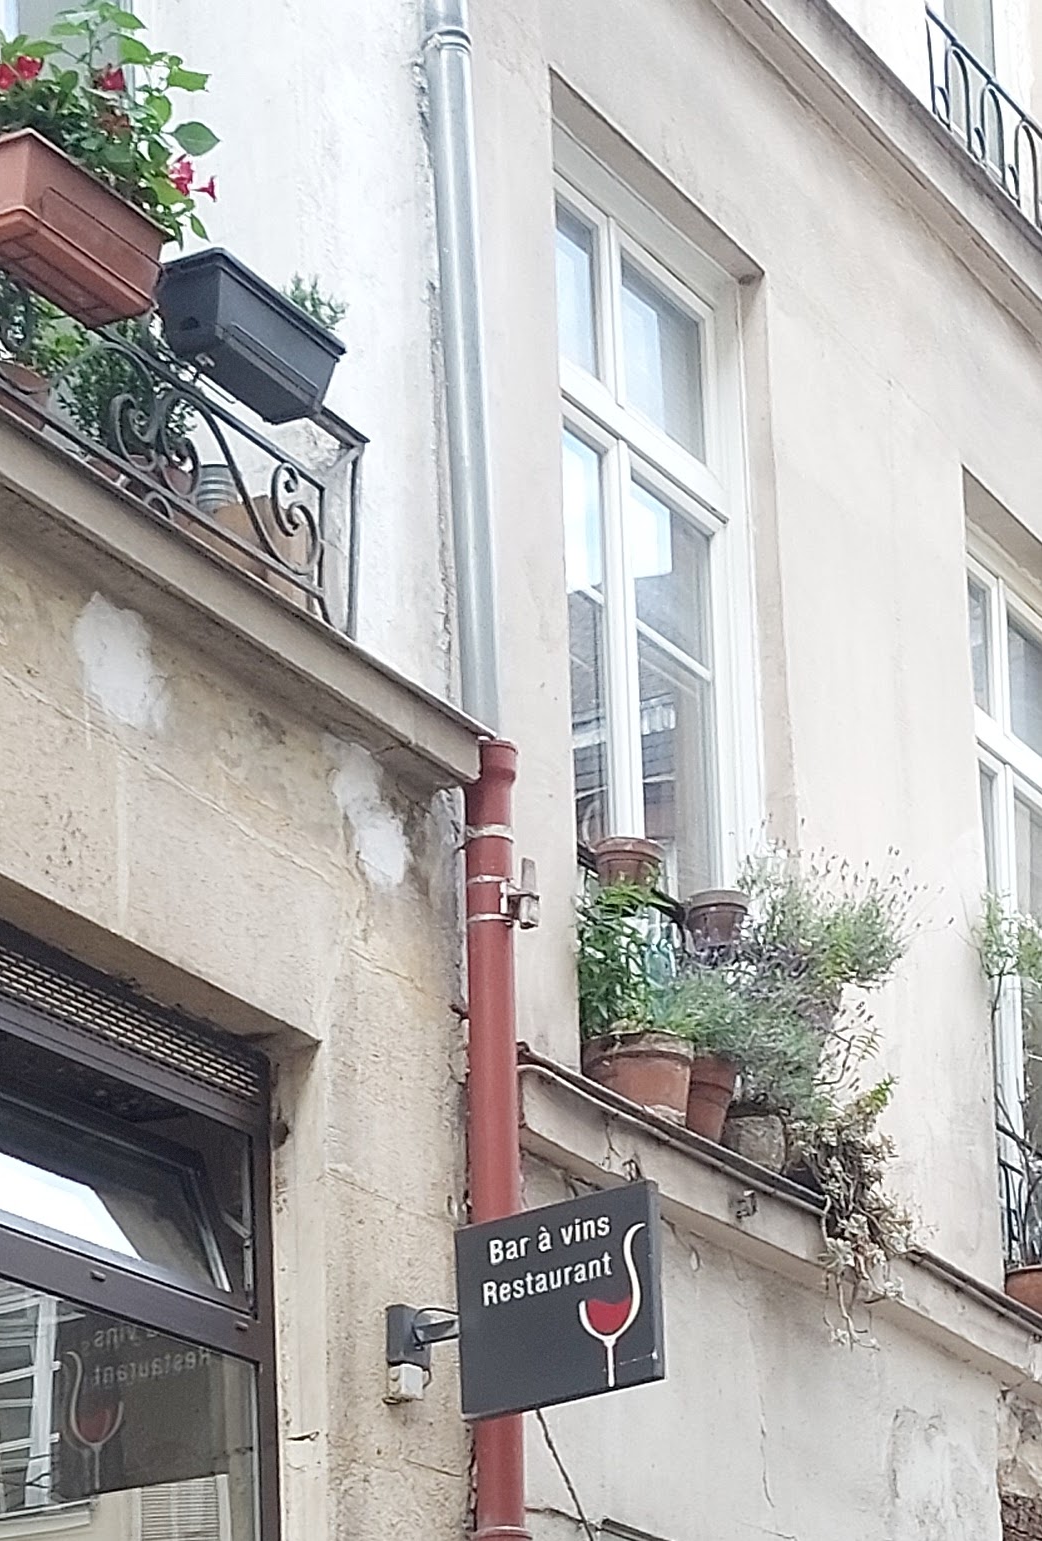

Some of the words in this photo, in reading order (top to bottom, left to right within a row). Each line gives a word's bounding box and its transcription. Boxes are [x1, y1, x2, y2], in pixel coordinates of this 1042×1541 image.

[489, 1237, 531, 1265] Bar
[538, 1226, 552, 1252] à
[560, 1216, 610, 1245] vins
[482, 1251, 612, 1307] Restaurant
